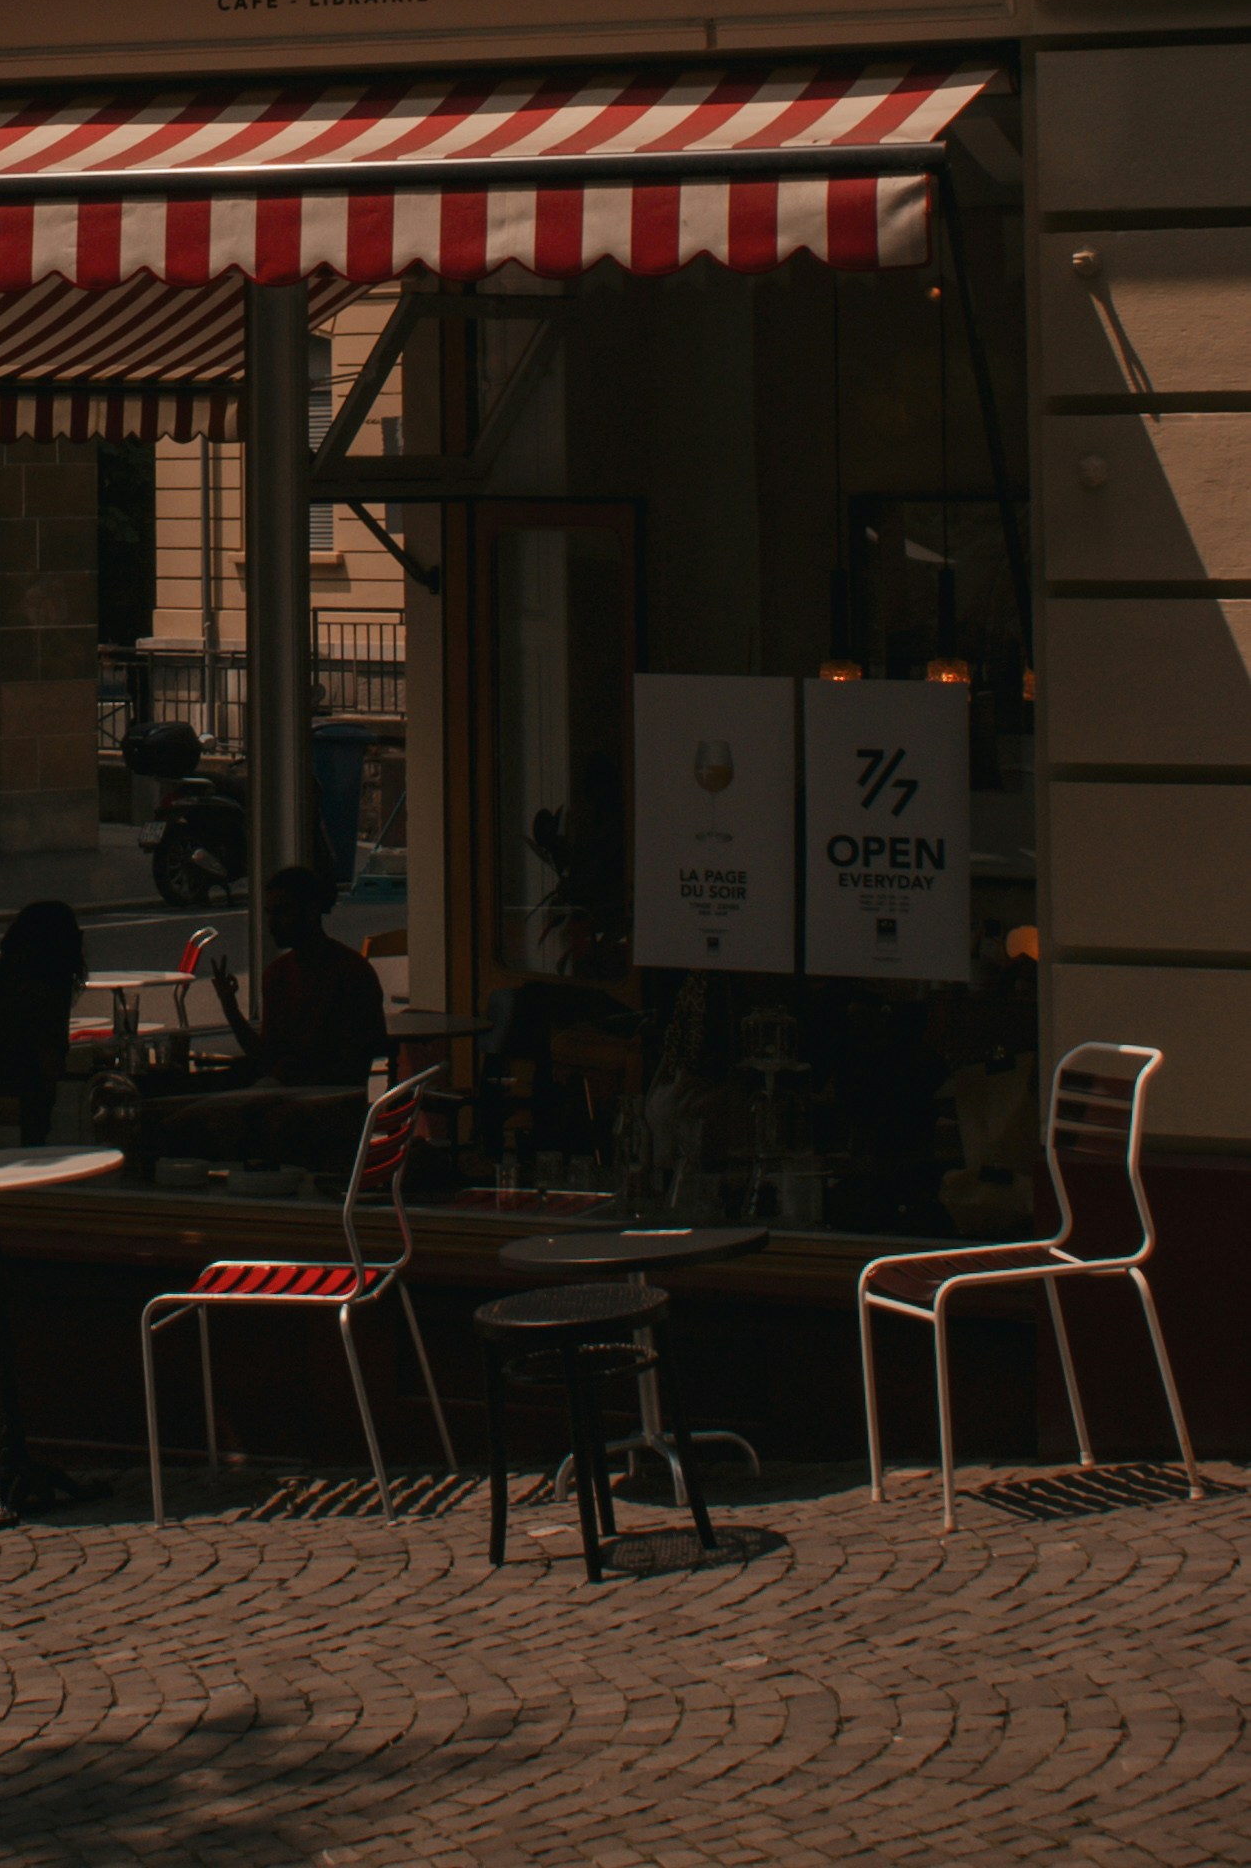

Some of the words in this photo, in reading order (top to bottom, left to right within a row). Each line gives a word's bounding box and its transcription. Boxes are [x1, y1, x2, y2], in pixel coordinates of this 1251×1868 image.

[856, 747, 919, 817] 7/7
[827, 834, 946, 871] OPEN
[679, 868, 699, 882] LA
[704, 869, 747, 885] PAGE
[838, 872, 934, 891] EVERYDAY
[680, 884, 704, 898] DU
[708, 885, 747, 900] SOIR
